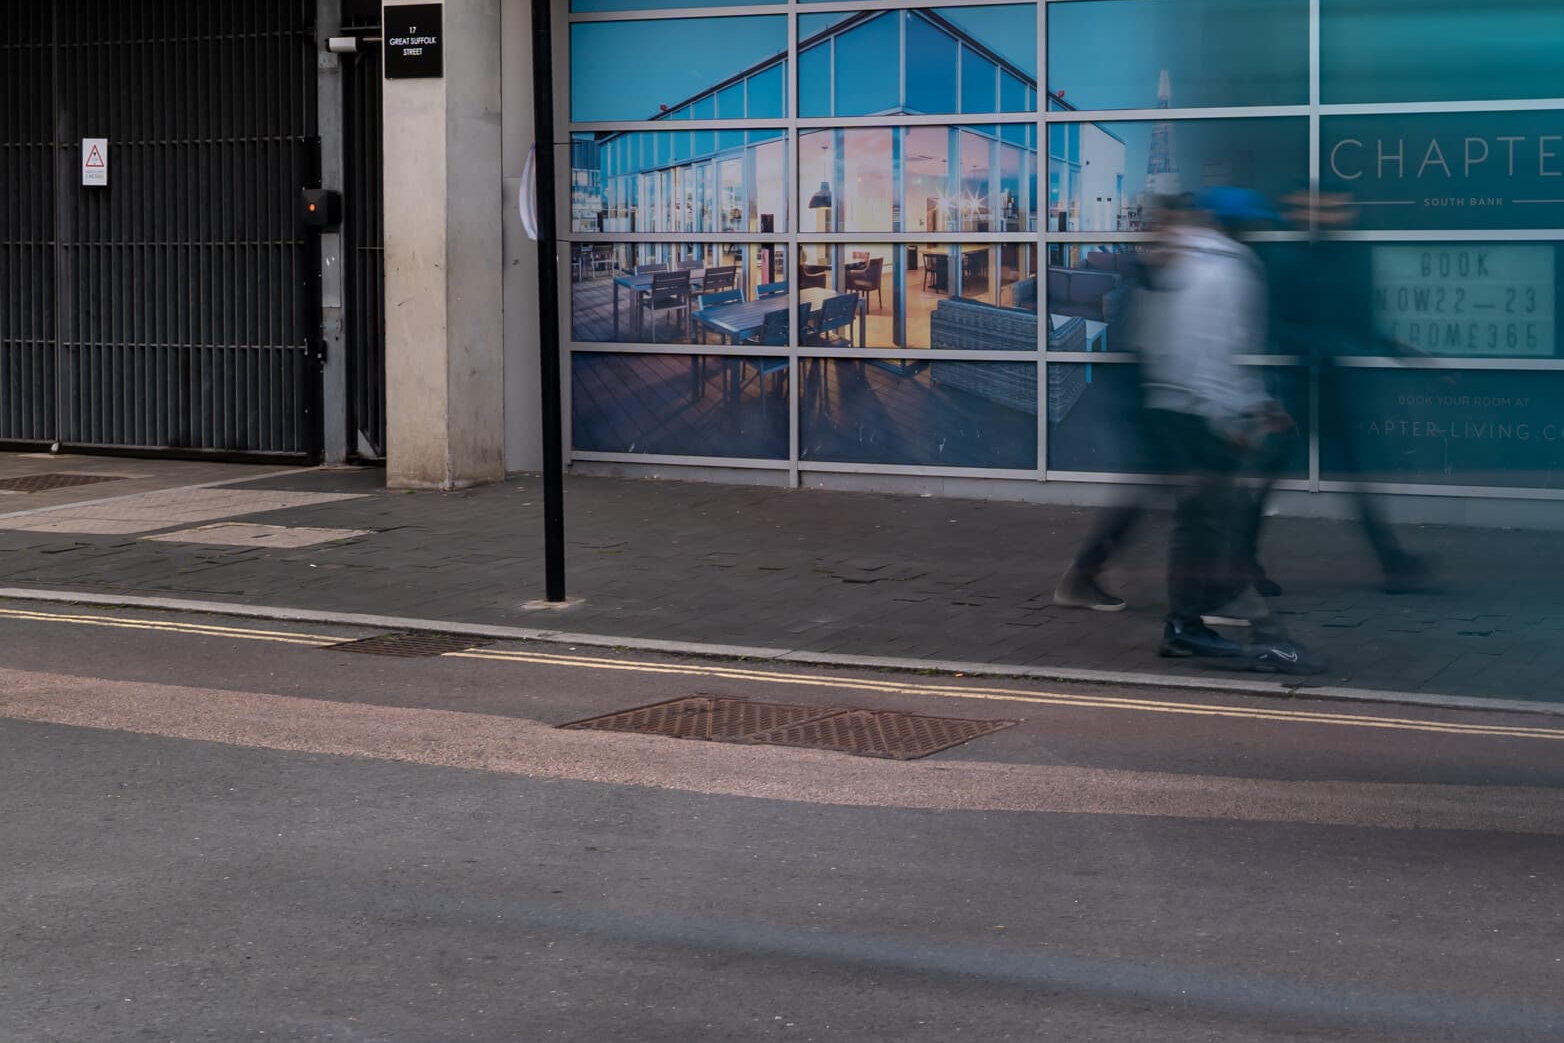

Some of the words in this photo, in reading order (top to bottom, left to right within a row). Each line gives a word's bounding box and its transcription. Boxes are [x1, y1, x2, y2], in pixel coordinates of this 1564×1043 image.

[409, 26, 417, 34] 17
[389, 37, 409, 46] GREAT
[410, 36, 437, 45] SUFFOLK
[402, 47, 423, 56] STREET
[1423, 197, 1465, 207] SOUTH
[1470, 196, 1504, 207] BANK
[1420, 252, 1489, 278] BOOK
[1437, 395, 1470, 407] YOUR
[1474, 396, 1511, 408] ROOM
[1514, 397, 1530, 408] AT
